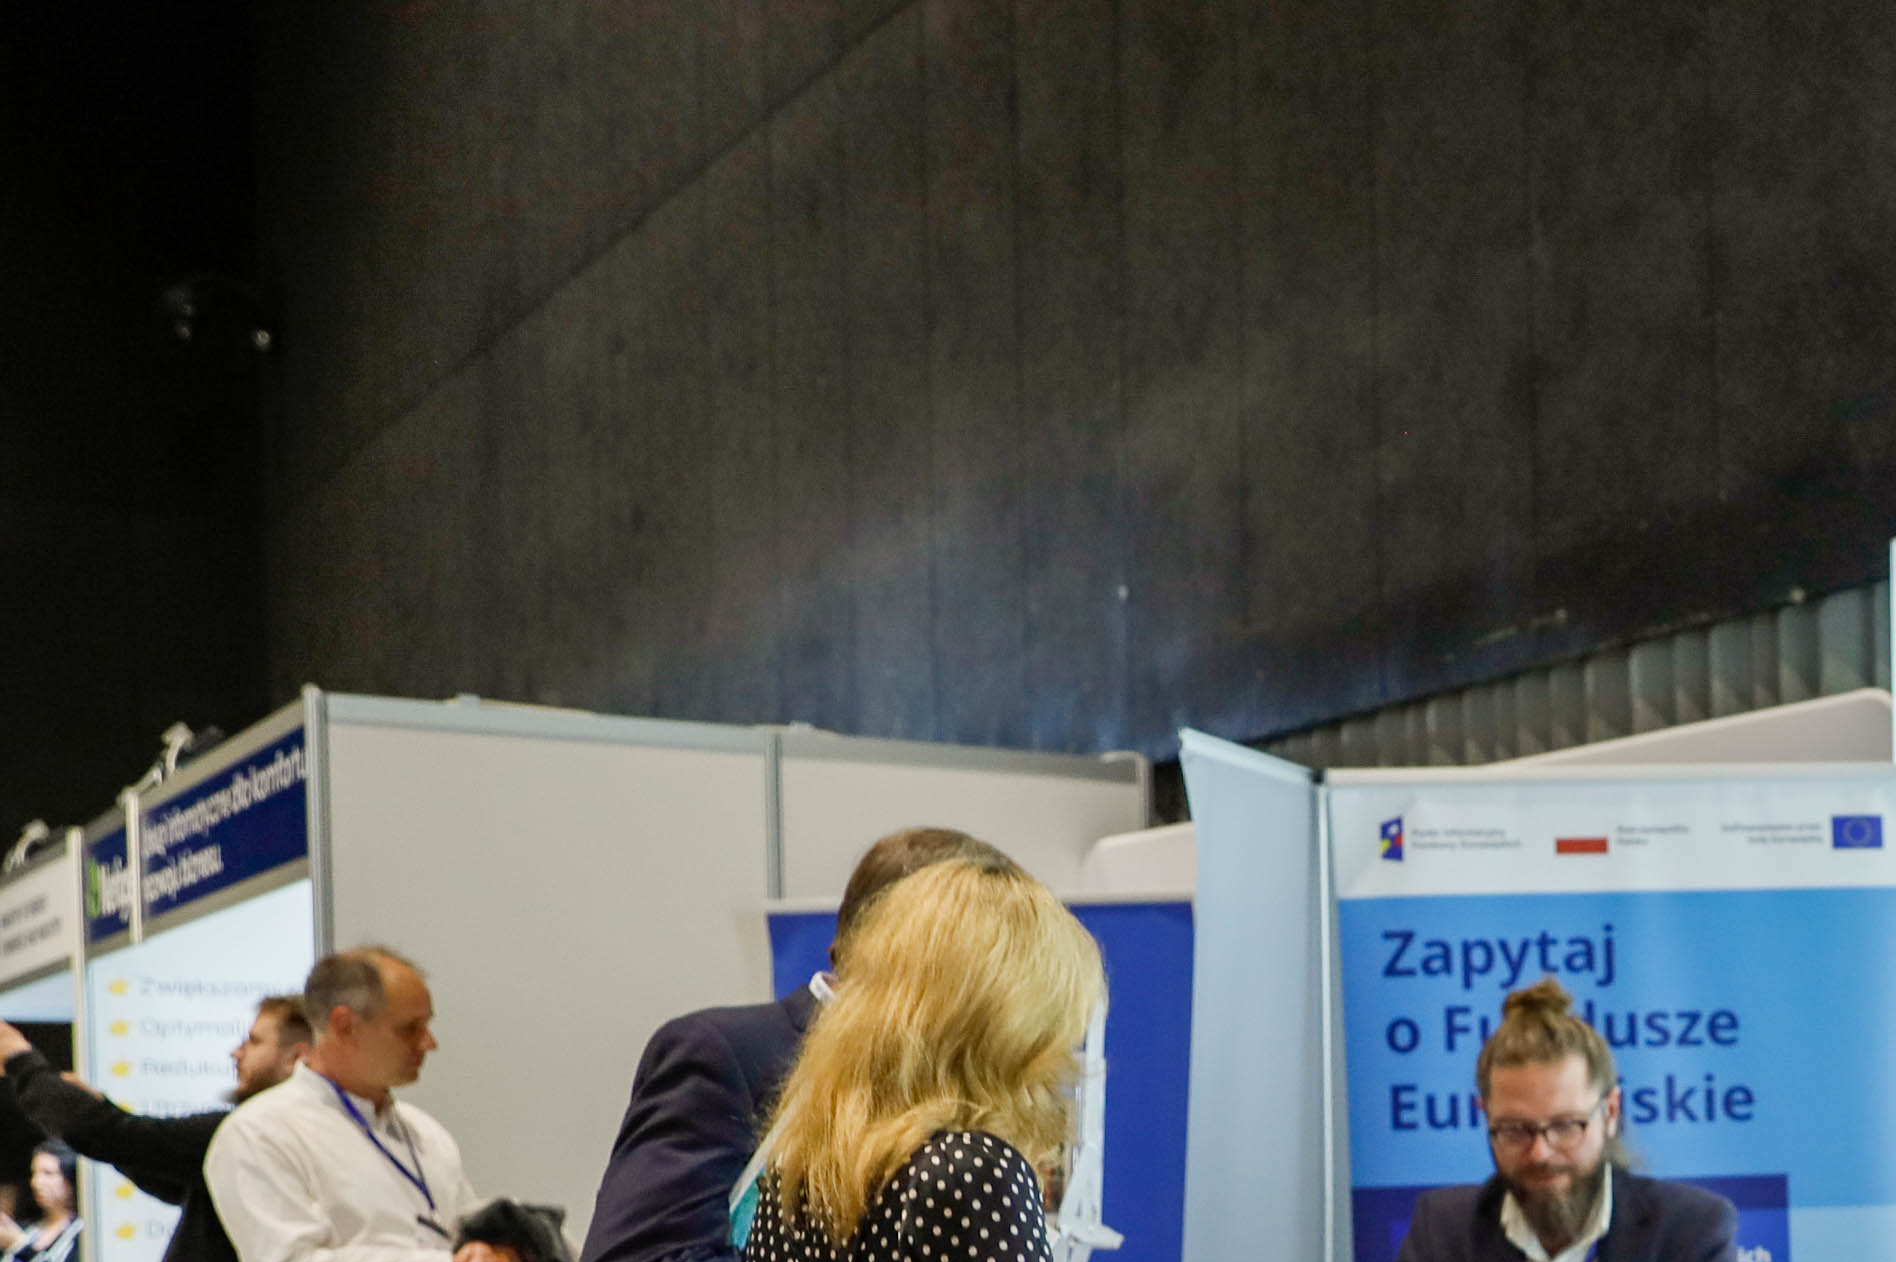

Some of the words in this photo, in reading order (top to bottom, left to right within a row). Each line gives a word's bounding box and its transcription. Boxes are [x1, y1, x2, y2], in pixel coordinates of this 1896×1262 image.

[1382, 924, 1616, 990] Zapytaj
[1385, 1016, 1421, 1054] o
[1443, 998, 1740, 1053] Fusze
